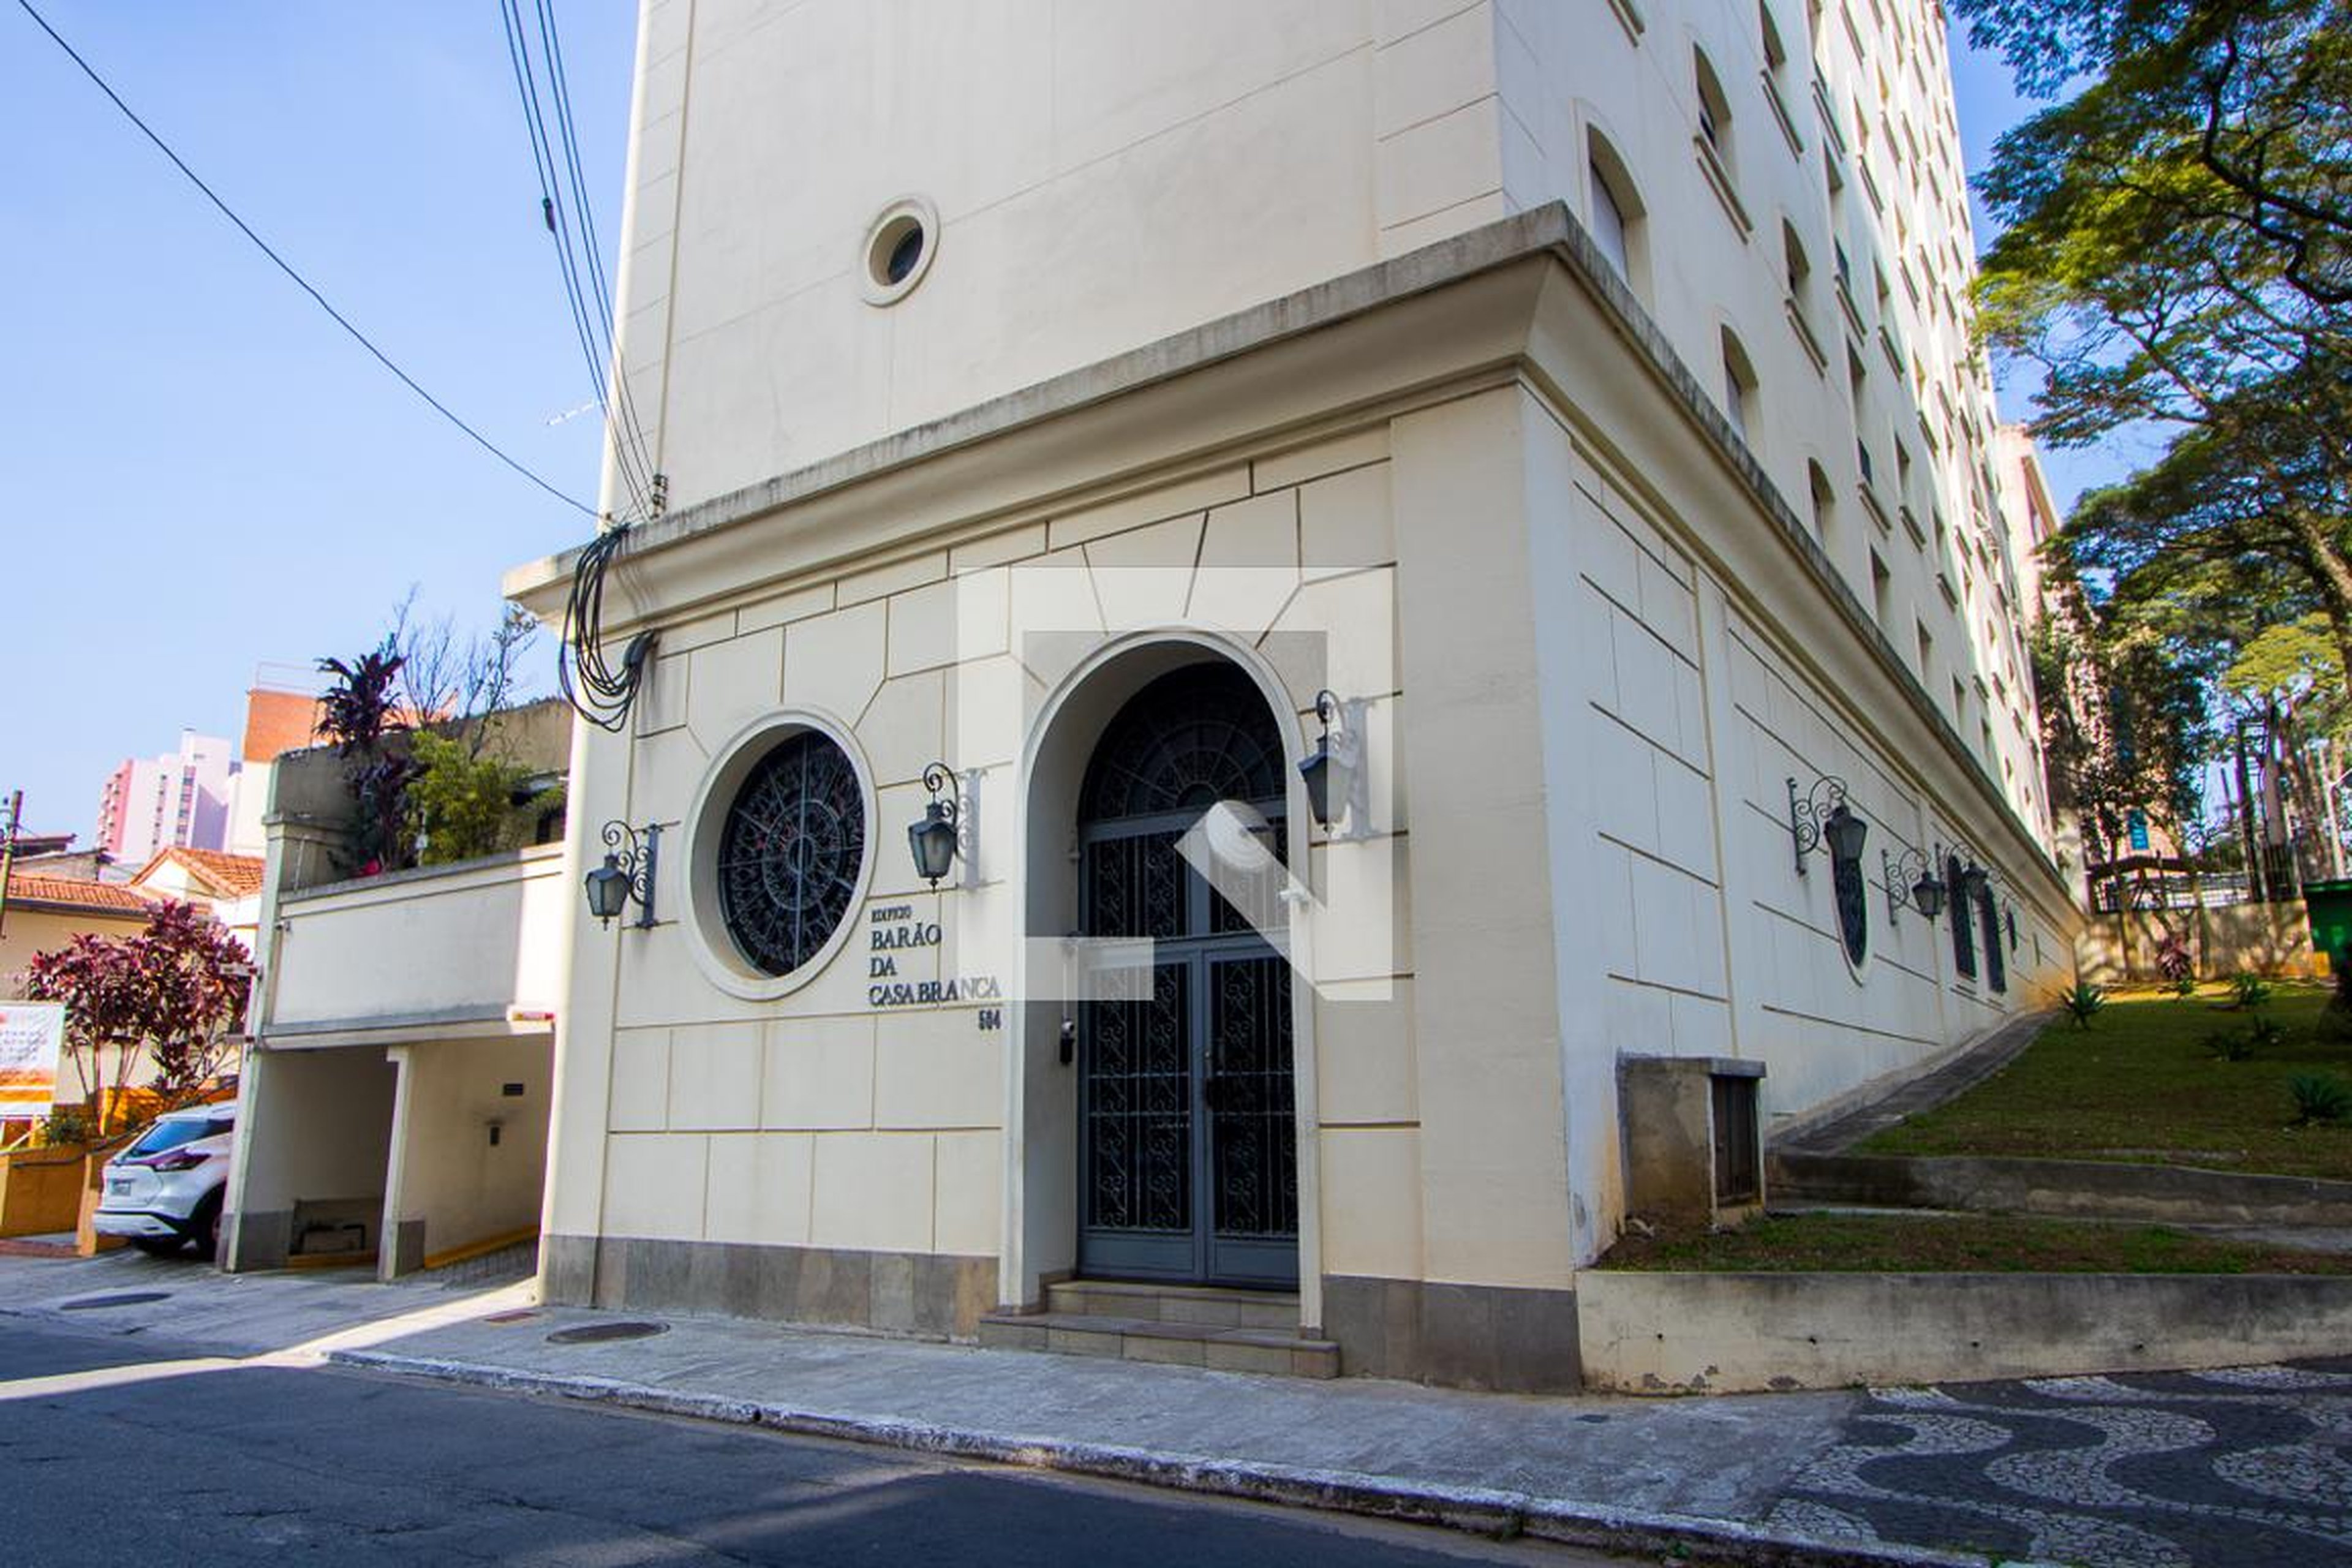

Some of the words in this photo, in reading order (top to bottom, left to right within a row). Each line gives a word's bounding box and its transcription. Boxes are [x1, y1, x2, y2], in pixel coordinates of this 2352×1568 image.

[871, 922, 942, 951] BARÃO
[869, 956, 897, 978] DA
[869, 983, 915, 1006] CASA
[917, 976, 1001, 1003] BRANCA
